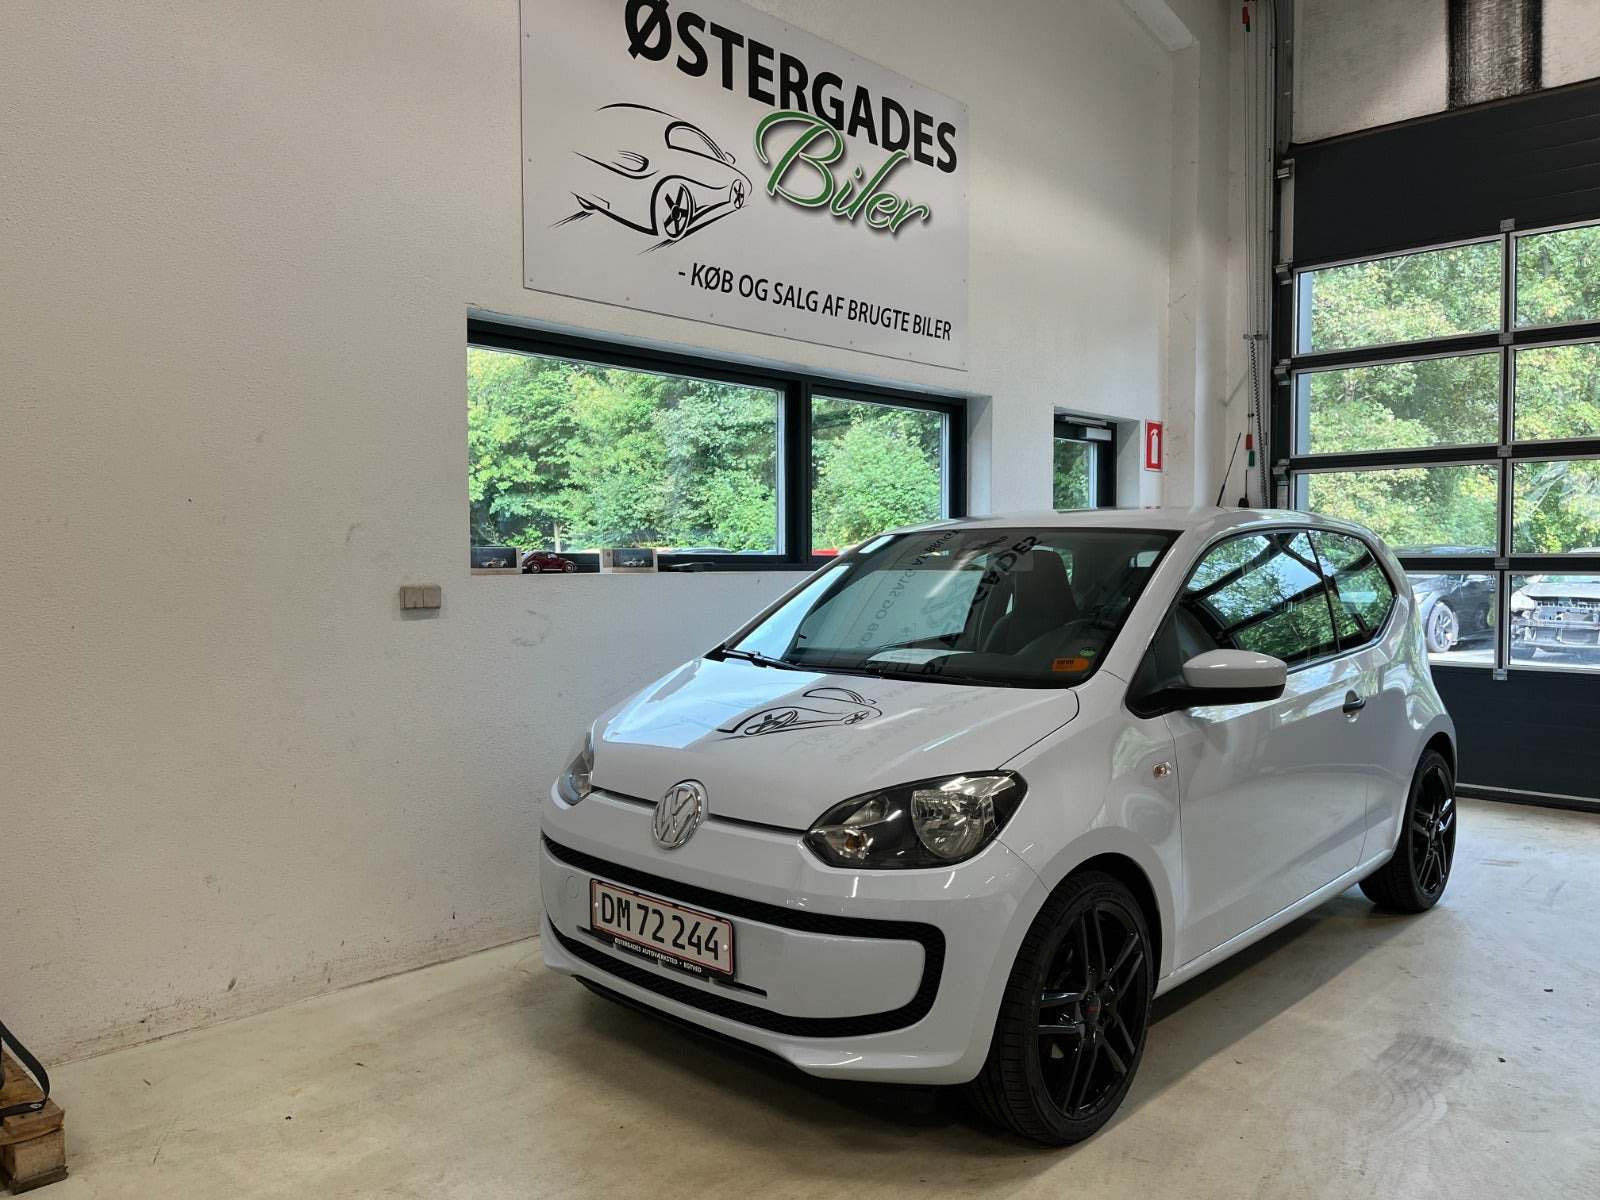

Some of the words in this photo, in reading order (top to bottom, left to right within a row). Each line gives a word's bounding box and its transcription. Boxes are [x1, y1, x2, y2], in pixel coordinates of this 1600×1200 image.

[624, 0, 957, 174] ØSTERGADES
[754, 109, 930, 234] Biler
[691, 262, 734, 294] KØB
[738, 274, 769, 302] OG
[772, 282, 819, 312] SALG
[822, 294, 845, 318] AF
[848, 300, 910, 332] BRUGTE
[913, 315, 952, 341] BILER
[601, 891, 631, 932] DM
[636, 903, 665, 944] 72
[671, 914, 719, 961] 244
